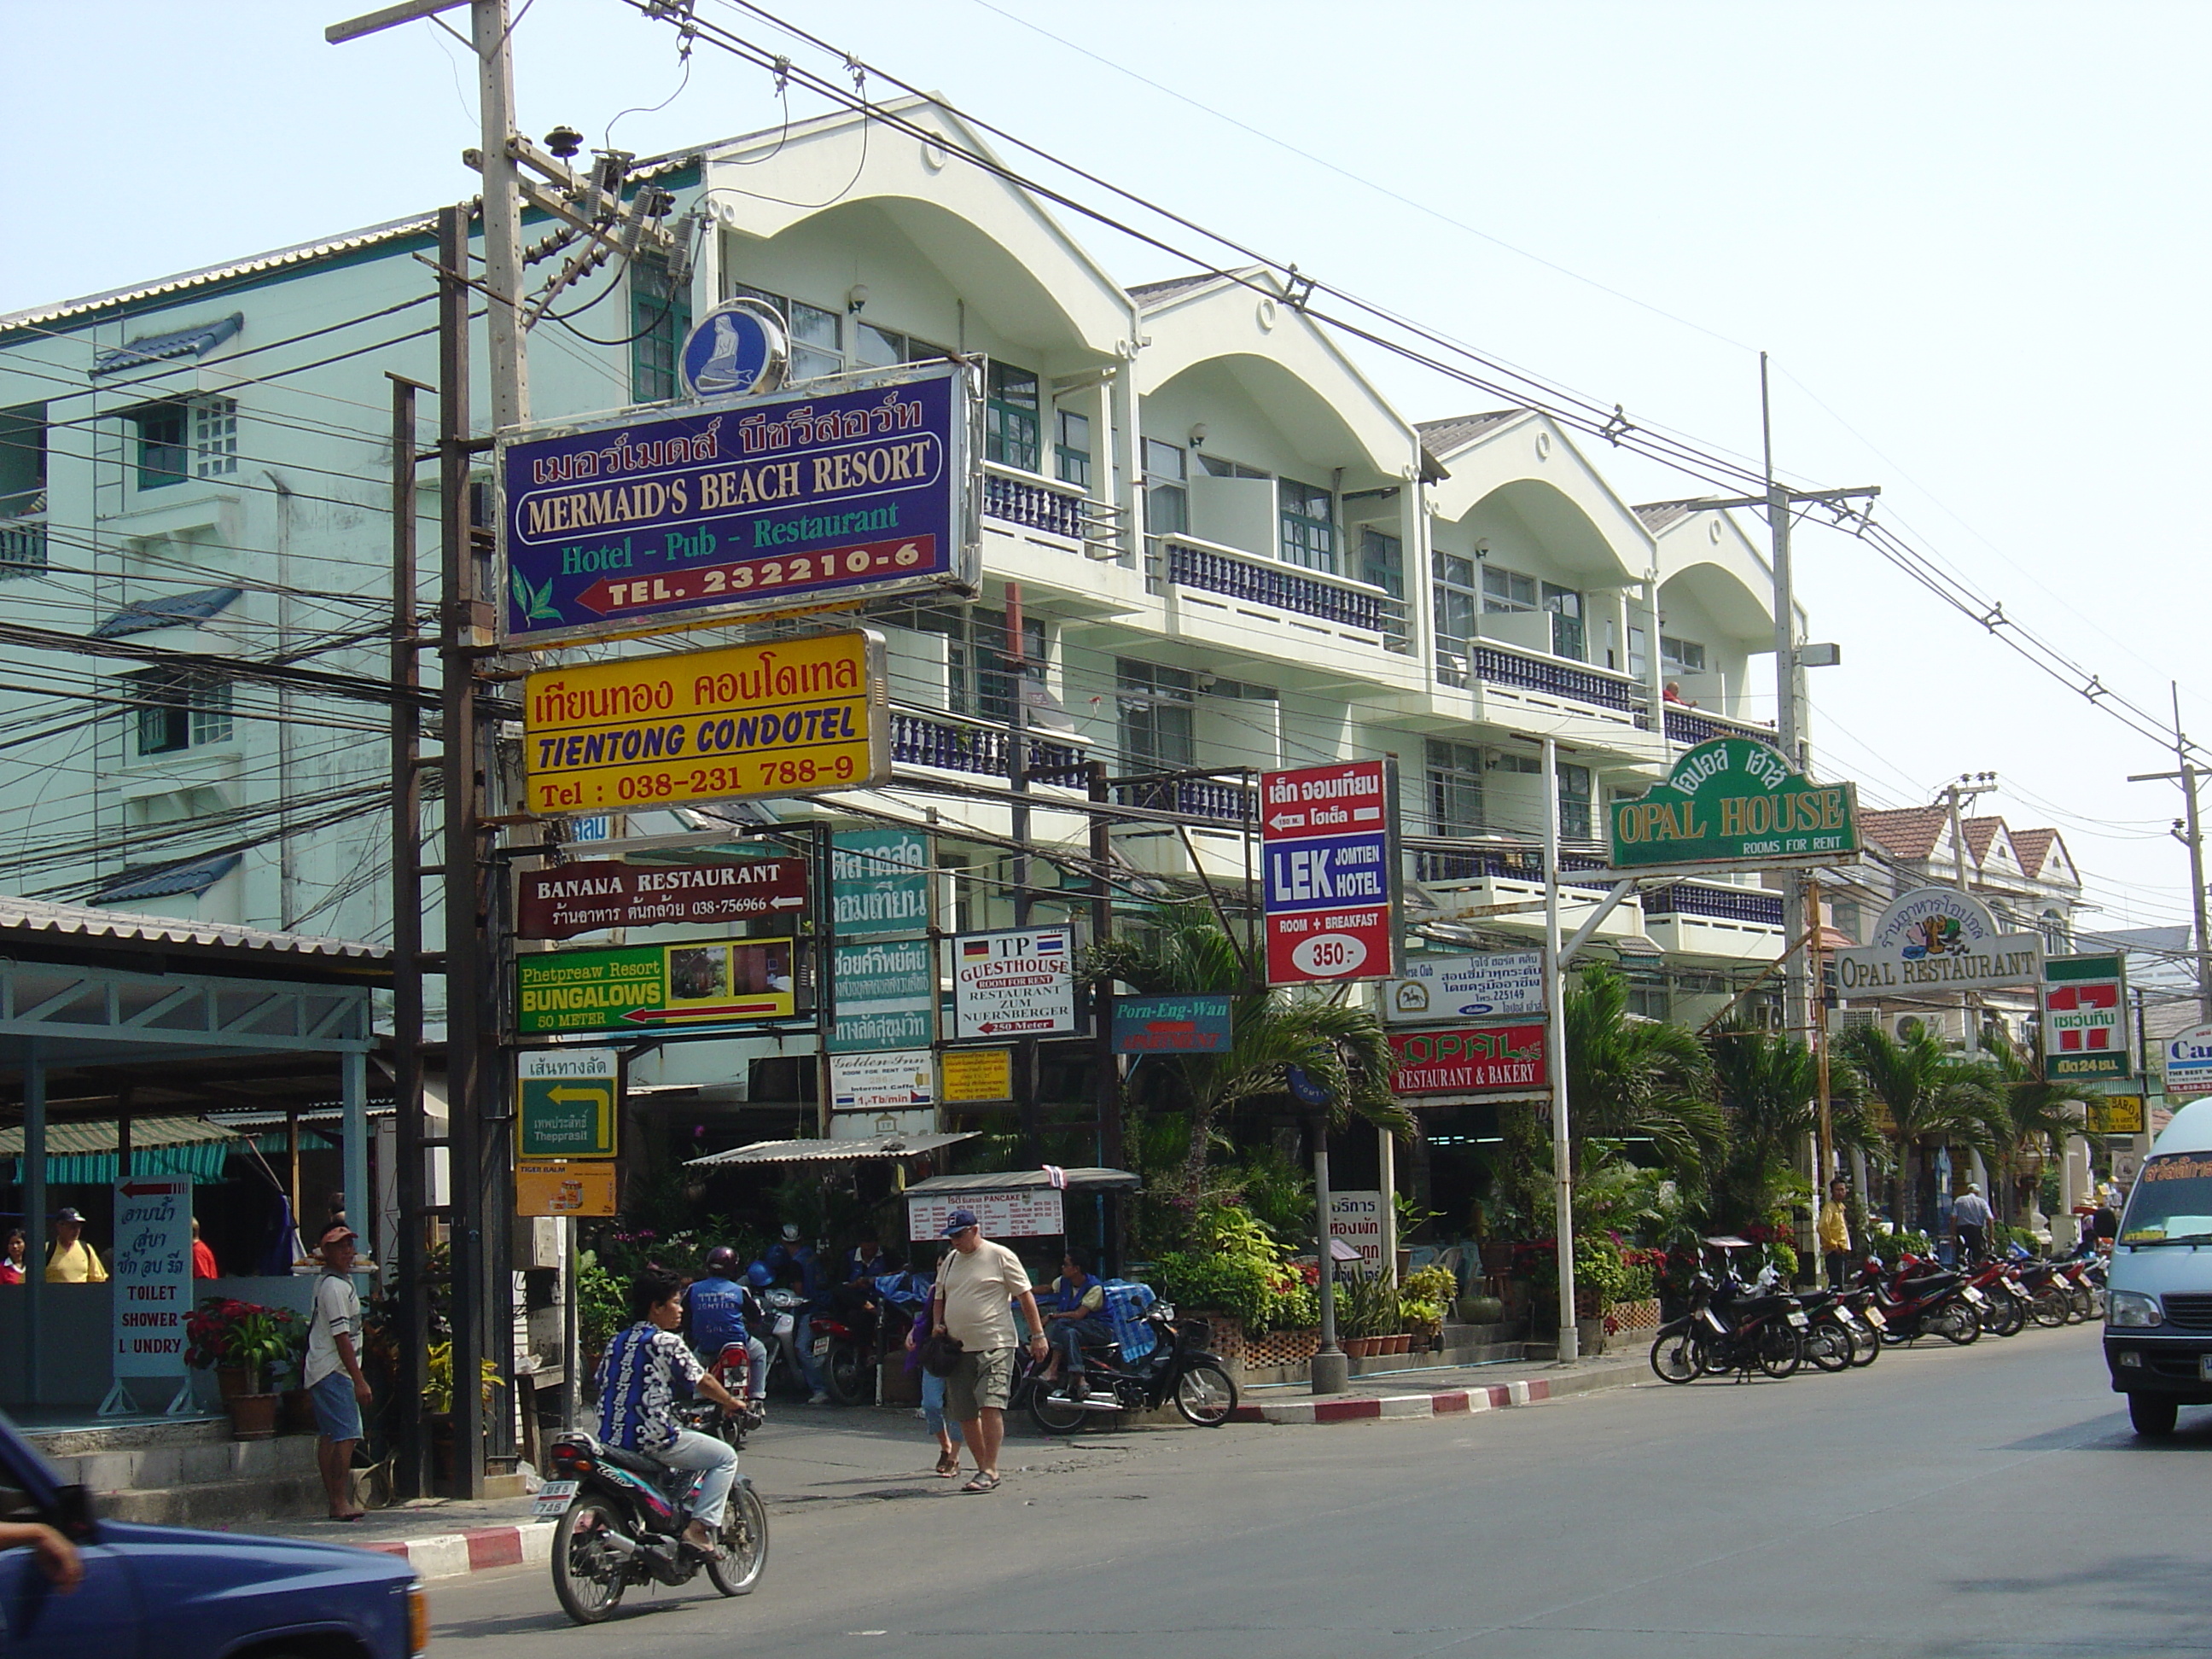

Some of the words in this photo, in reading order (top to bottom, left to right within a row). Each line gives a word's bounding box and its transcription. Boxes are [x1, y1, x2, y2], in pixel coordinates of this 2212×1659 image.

[533, 416, 723, 485] เมอร์เมดส์
[739, 391, 923, 453] บีชรีสอร์ท
[527, 478, 687, 535] MERMAID'S
[700, 461, 800, 510] BEACH
[813, 439, 932, 492] RESORT
[562, 536, 633, 576] Hotel
[665, 526, 717, 562] Pub
[754, 502, 899, 548] Restaurant
[608, 576, 685, 606] TEL.
[703, 543, 919, 595] 232210-6
[536, 680, 674, 724] เทียนทอง
[694, 651, 859, 706] คอนโดเทล
[538, 725, 685, 768] TIENTONG
[696, 706, 856, 753] CONDOTEL
[618, 766, 742, 800] 038-231
[760, 755, 853, 787] 788-9
[1269, 777, 1299, 804] เล็ก
[1301, 771, 1379, 800] จอมเทียน
[1310, 805, 1348, 826] โฮเต็ล
[1619, 800, 1707, 844] OPAL
[1720, 789, 1844, 836] HOUSE
[1335, 845, 1380, 866] JOMTIEN
[1743, 840, 1780, 855] ROOMS
[1786, 839, 1807, 853] FOR
[1813, 835, 1842, 851] RENT
[538, 876, 624, 900] BANANA
[637, 864, 781, 893] RESTAURANT
[1274, 848, 1334, 901] LEK
[1336, 871, 1382, 897] HOTEL
[553, 903, 621, 926] ร้านอาหาร
[627, 894, 685, 921] ต้นกล้วย
[692, 897, 767, 915] 038-756966
[1280, 918, 1308, 933] ROOM
[1325, 913, 1379, 930] BREAKFAST
[522, 967, 604, 984] Phetpreaw
[609, 961, 661, 977] Resort
[960, 958, 1069, 983] GUESTHOUSE
[1419, 964, 1434, 977] Club
[1841, 957, 1896, 989] OPAL
[1901, 951, 2035, 984] RESTAURANT
[979, 980, 1006, 989] ROOM
[1008, 977, 1026, 986] FOR
[1027, 975, 1052, 984] RENT
[522, 982, 661, 1012] BUNGALOWS
[969, 986, 1062, 1001] RESTAURANT
[1000, 998, 1031, 1009] ZUM
[559, 1012, 606, 1027] METER
[963, 1006, 1068, 1022] NUERNBERGER
[1116, 1001, 1227, 1021] Porn-Eng-Wan
[836, 1012, 925, 1045] ทางลัดสุขุมวิท
[992, 1022, 1012, 1032] 250
[1015, 1021, 1049, 1030] Meter
[1120, 1033, 1220, 1050] APARTMENT
[1404, 1033, 1536, 1064] OPAL
[530, 1056, 607, 1075] เส้นทางลัด
[834, 1057, 887, 1068] Golden
[2079, 1059, 2097, 1072] 24
[1399, 1067, 1473, 1090] RESTAURANT
[1476, 1066, 1485, 1086] &
[1488, 1063, 1535, 1084] BAKERY
[533, 1130, 588, 1143] Thepprasit
[127, 1285, 178, 1301] TOILET
[122, 1312, 178, 1327] SHOWER
[538, 1502, 562, 1512] 746
